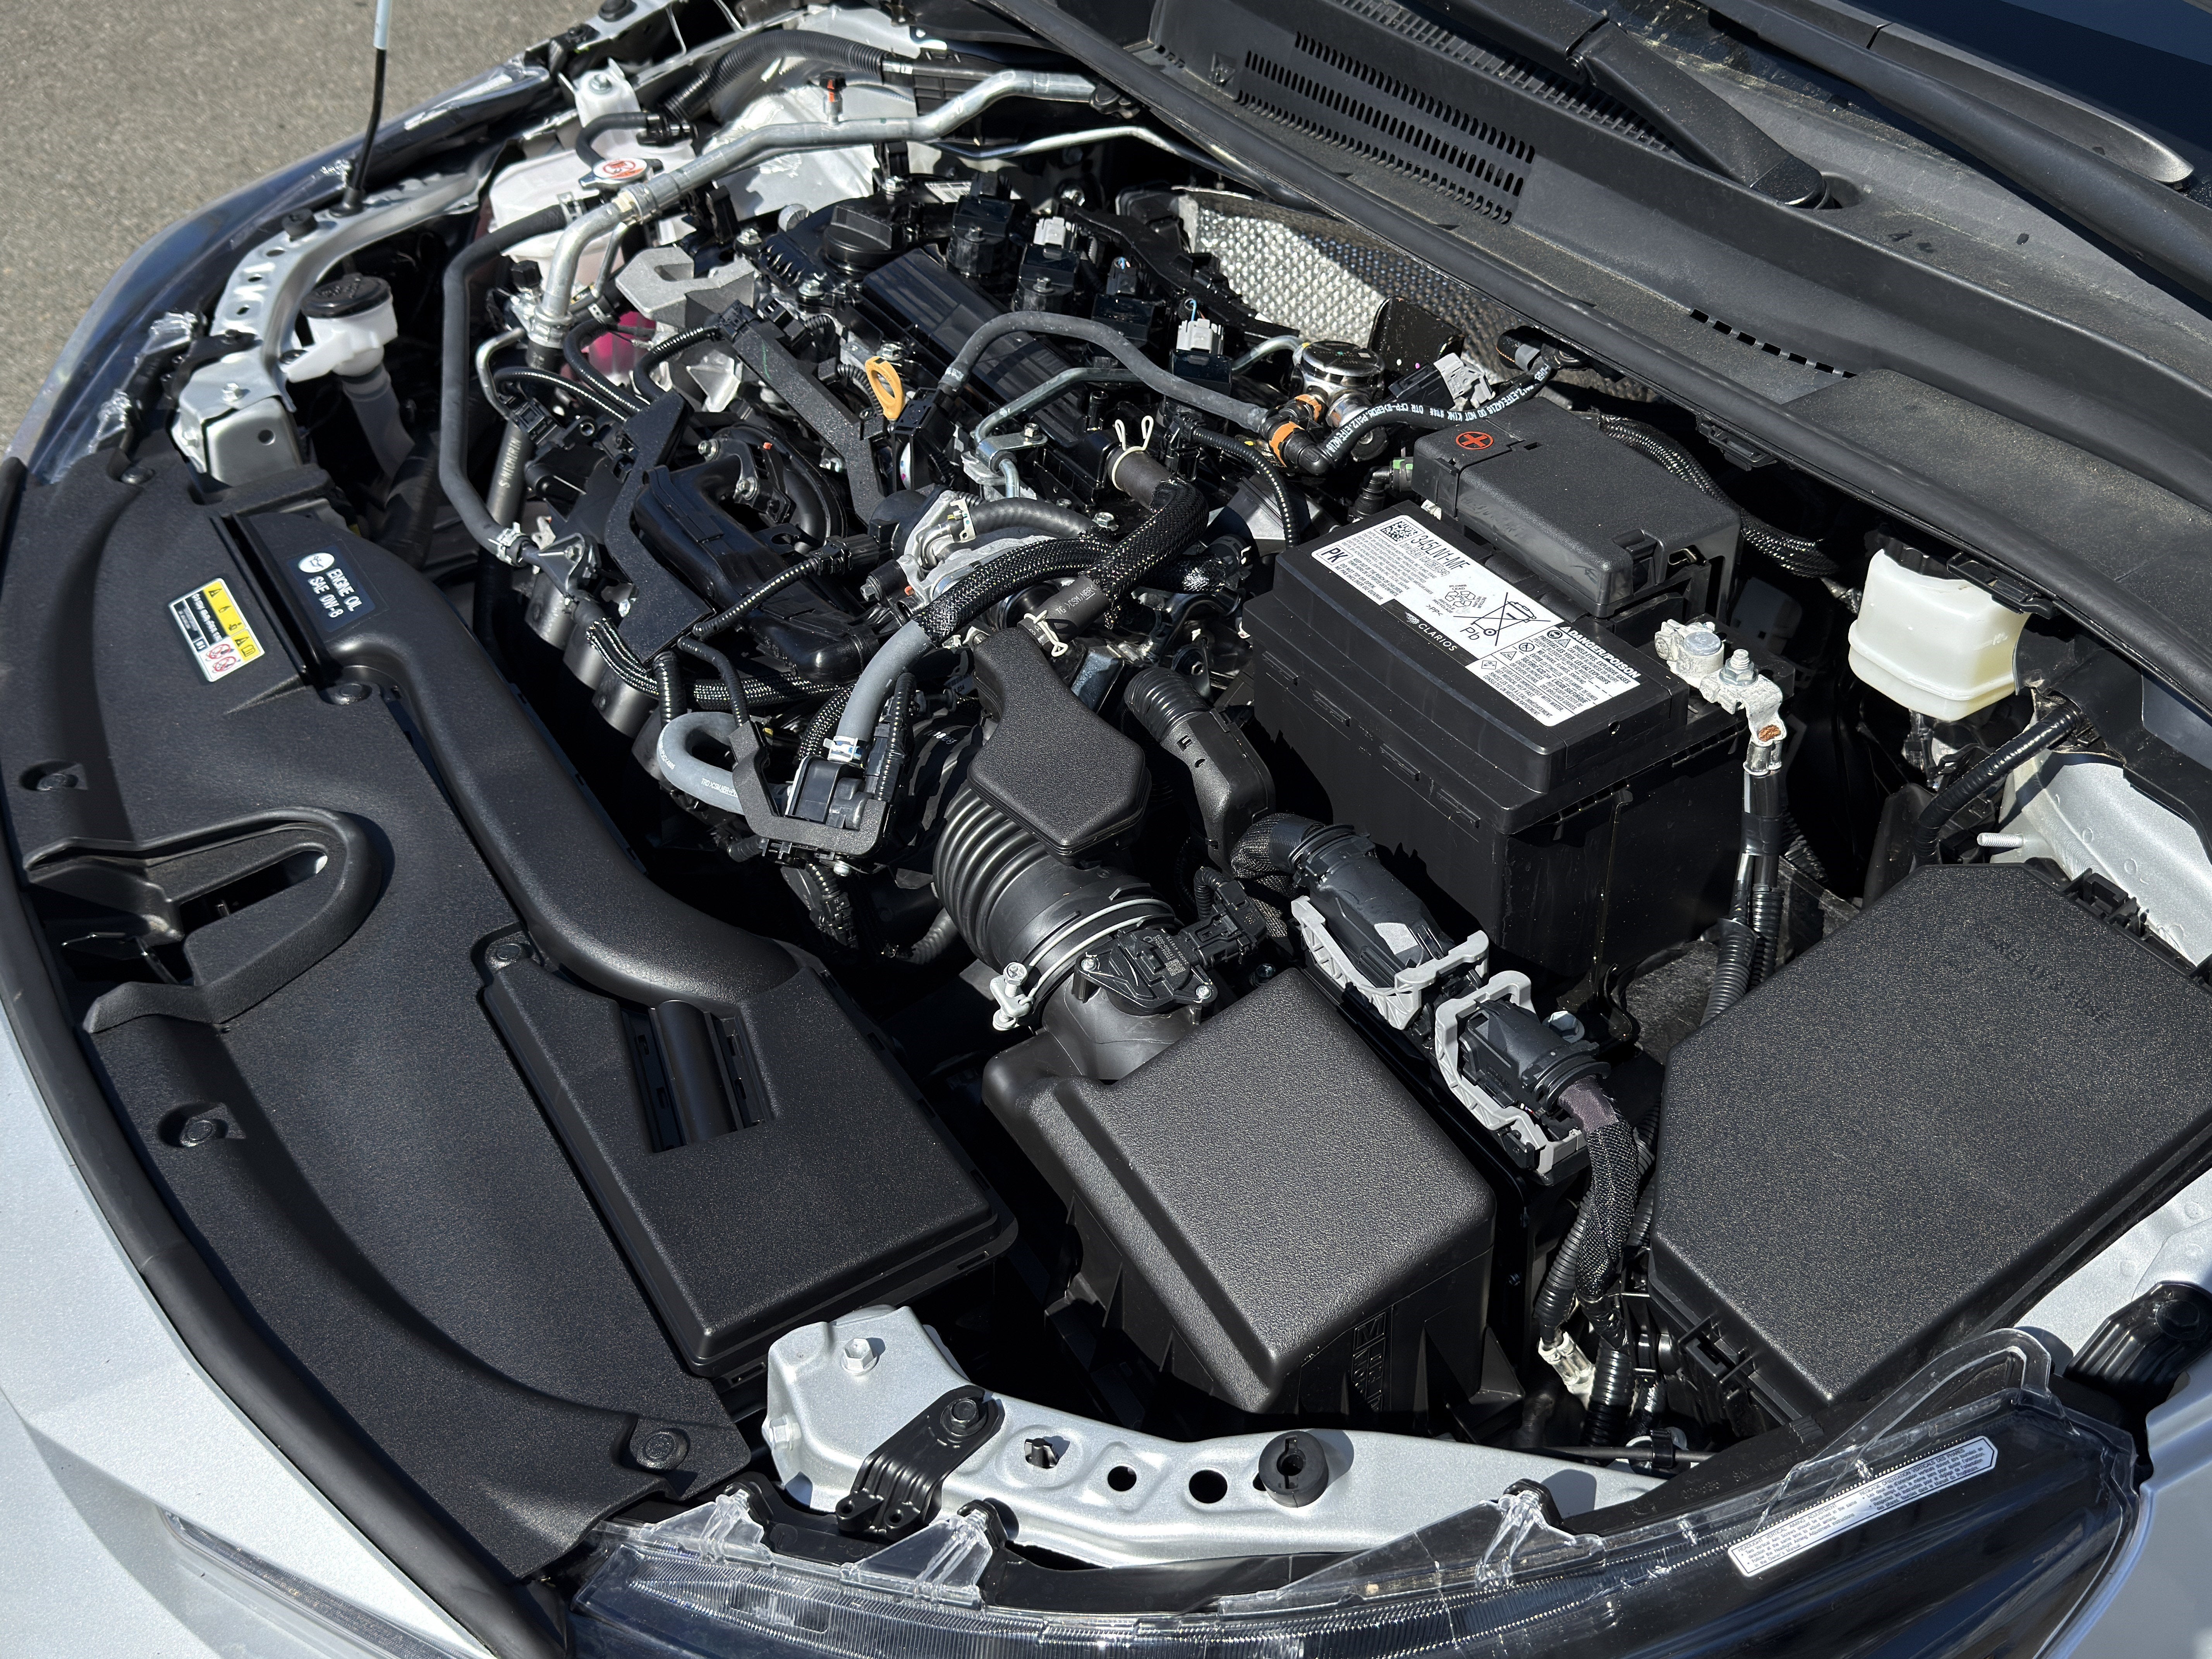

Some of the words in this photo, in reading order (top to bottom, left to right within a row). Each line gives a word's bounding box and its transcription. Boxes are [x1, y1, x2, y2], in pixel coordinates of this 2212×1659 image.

[1447, 411, 1462, 421] KINK
[1465, 411, 1477, 421] NOT
[1321, 547, 1348, 563] PK
[1410, 535, 1470, 570] 345LN1-MF
[1435, 568, 1451, 577] (SAE)
[309, 576, 330, 594] SAE
[326, 568, 354, 597] ENGINE
[344, 596, 362, 611] OIL
[1346, 574, 1365, 586] INCLINER
[1367, 589, 1385, 601] OUVRIR.
[1363, 580, 1377, 589] OPEN.
[1387, 582, 1404, 594] CHILDREN.
[319, 594, 344, 618] 0W-8
[1055, 606, 1066, 615] TG
[1432, 599, 1453, 613] RECYCLAGE
[1437, 599, 1455, 610] RECYCLE
[1472, 596, 1481, 607] RETURN
[1477, 597, 1487, 608] RETOUR
[1418, 623, 1457, 651] CLARIOS
[1460, 627, 1480, 640] Pb
[1520, 657, 1539, 669] SULFURIC
[1532, 637, 1549, 648] PEUVENT
[1546, 647, 1563, 658] BLESSER
[1565, 660, 1580, 670] RENDRE
[1577, 669, 1595, 680] AVEUGLE.
[1568, 630, 1641, 678] DANGER/POISON
[1572, 645, 1588, 655] SHIELD
[1585, 653, 1598, 662] EYES.
[1595, 661, 1618, 675] EXPLOSIVE
[1615, 674, 1631, 684] GASES
[1487, 672, 1502, 681] RINCEZ
[1513, 666, 1528, 675] SEVERE
[1525, 674, 1540, 684] BURNS.
[1514, 660, 1528, 668] CAUSE
[1525, 667, 1545, 680] BLINDNESS
[1541, 654, 1558, 664] SPARKS,
[1554, 663, 1571, 674] FLAMES,
[1568, 672, 1587, 684] SMOKING
[1563, 652, 1577, 661] YEUX.
[1588, 670, 1611, 684] EXPLOSIFS
[1573, 652, 1586, 660] CAUSE
[1583, 659, 1603, 672] BLINDNESS
[1605, 674, 1620, 683] INJURY.
[1500, 666, 1514, 675] FLUSH
[1518, 680, 1543, 696] IMMEDIATELY
[1540, 695, 1552, 703] WITH
[1549, 701, 1565, 712] WATER.
[1501, 674, 1518, 685] MEDICAL
[1551, 678, 1568, 689] L'ACIDE
[1564, 687, 1588, 703] SULFURIQUE
[1481, 675, 1502, 689] CONSULTEZ
[1517, 700, 1541, 716] RAPIDEMENT.
[1561, 700, 1578, 711] GRAVES.
[1153, 936, 1171, 960] 22204-75040
[1737, 1538, 1764, 1552] HEADLIGHT
[1764, 1527, 1787, 1539] VERTICAL
[1788, 1518, 1806, 1528] AIMING
[1807, 1503, 1837, 1519] ADJUSTMENT
[1754, 1540, 1771, 1550] Vertical
[1780, 1528, 1796, 1538] Screws
[1796, 1522, 1811, 1530] should
[1818, 1512, 1832, 1520] turned
[1748, 1549, 1765, 1559] direction
[1808, 1522, 1822, 1531] adjust
[1751, 1554, 1765, 1563] Follow
[1773, 1542, 1793, 1553] Headlight
[1808, 1523, 1832, 1537] Adjustment
